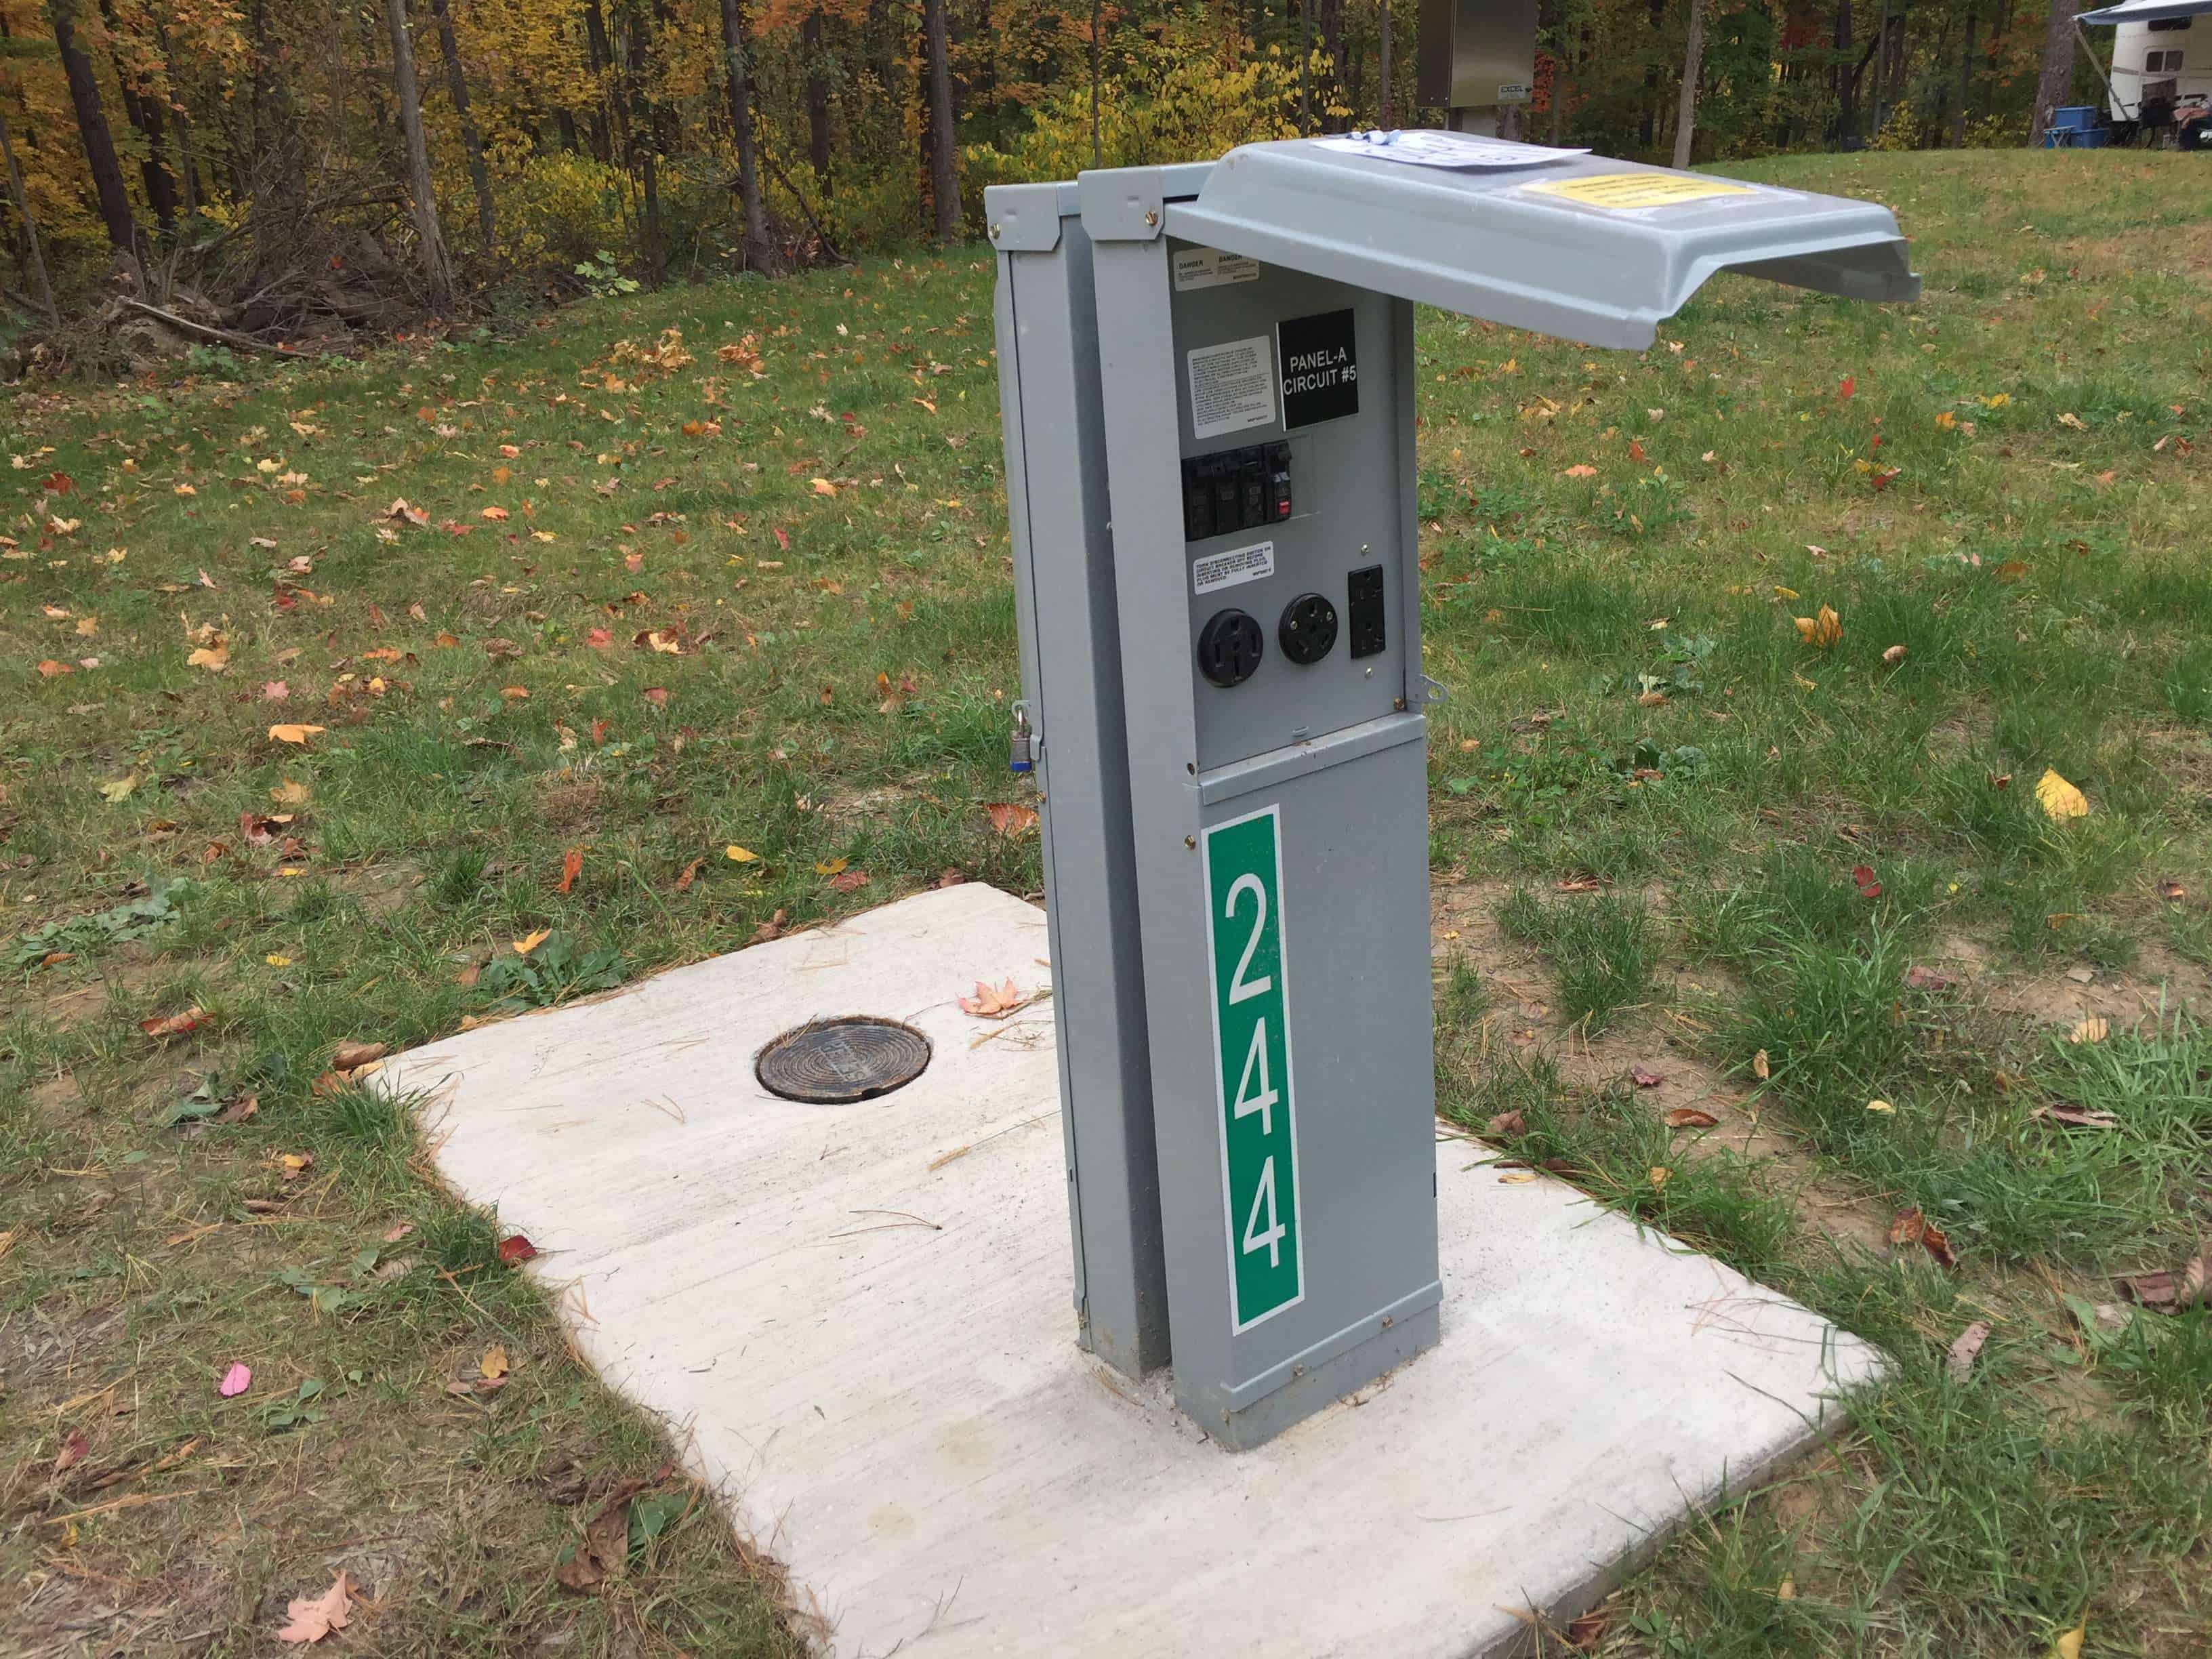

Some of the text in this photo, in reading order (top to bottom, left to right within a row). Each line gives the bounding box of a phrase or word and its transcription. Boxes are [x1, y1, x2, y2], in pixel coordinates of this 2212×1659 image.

[1290, 346, 1347, 373] PANEL-A
[1283, 365, 1357, 395] CIRCUIT #5
[1224, 872, 1286, 1269] 2244
